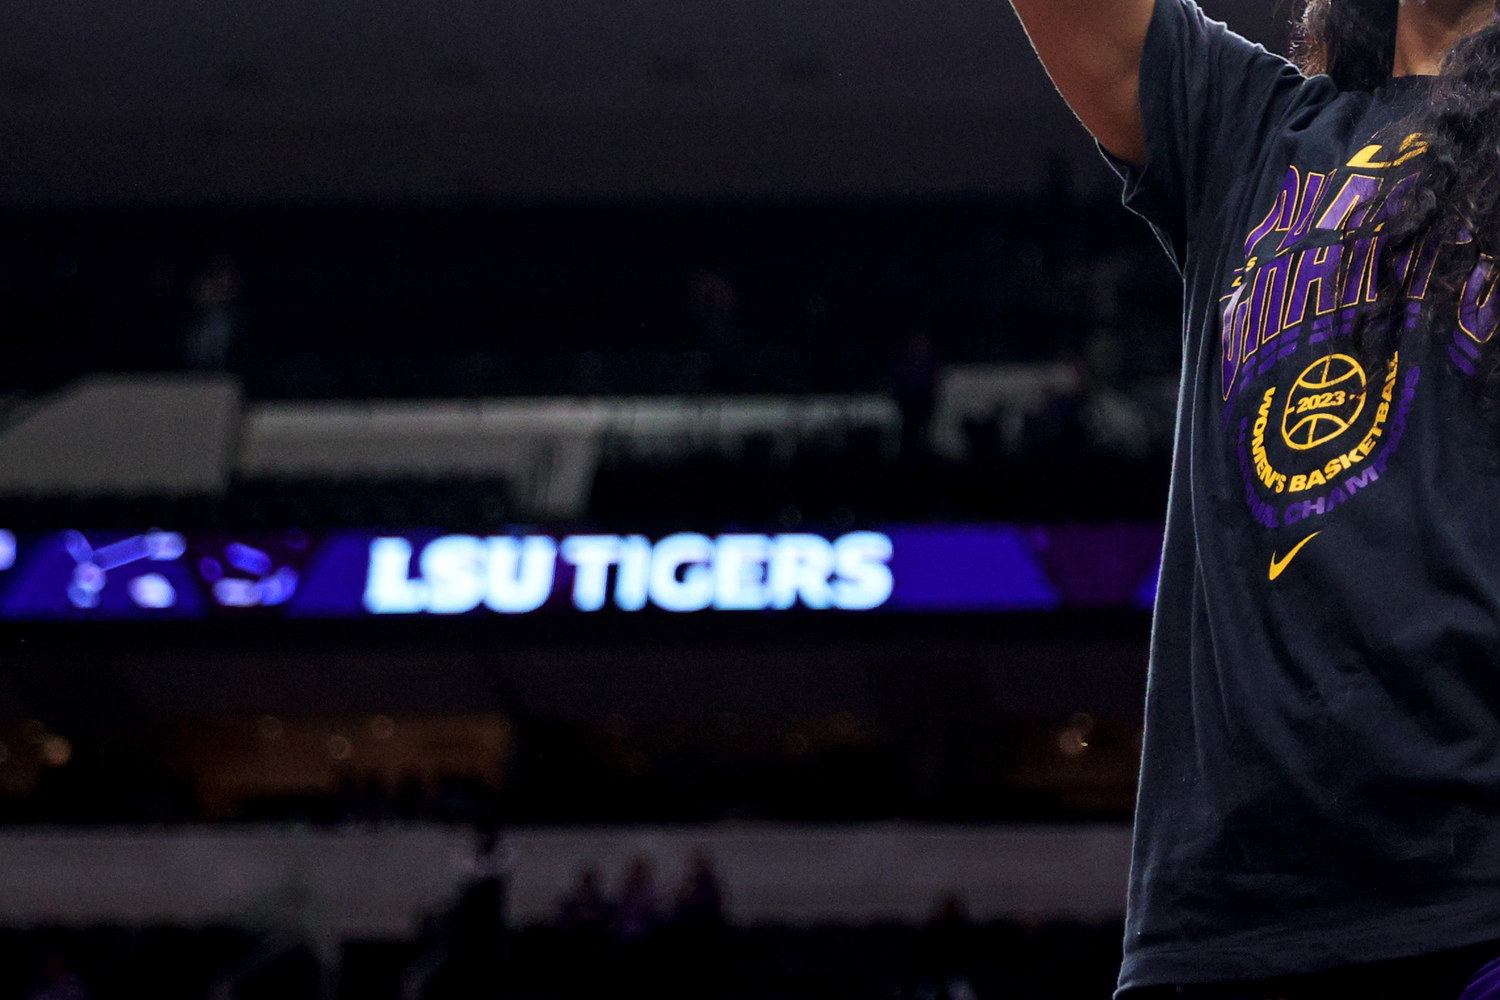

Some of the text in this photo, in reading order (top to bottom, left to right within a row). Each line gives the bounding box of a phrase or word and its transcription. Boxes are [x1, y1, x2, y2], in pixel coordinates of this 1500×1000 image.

[1251, 386, 1288, 494] WOMEN'S
[1296, 390, 1346, 414] 2023
[366, 531, 894, 614] LSU TIGERS
